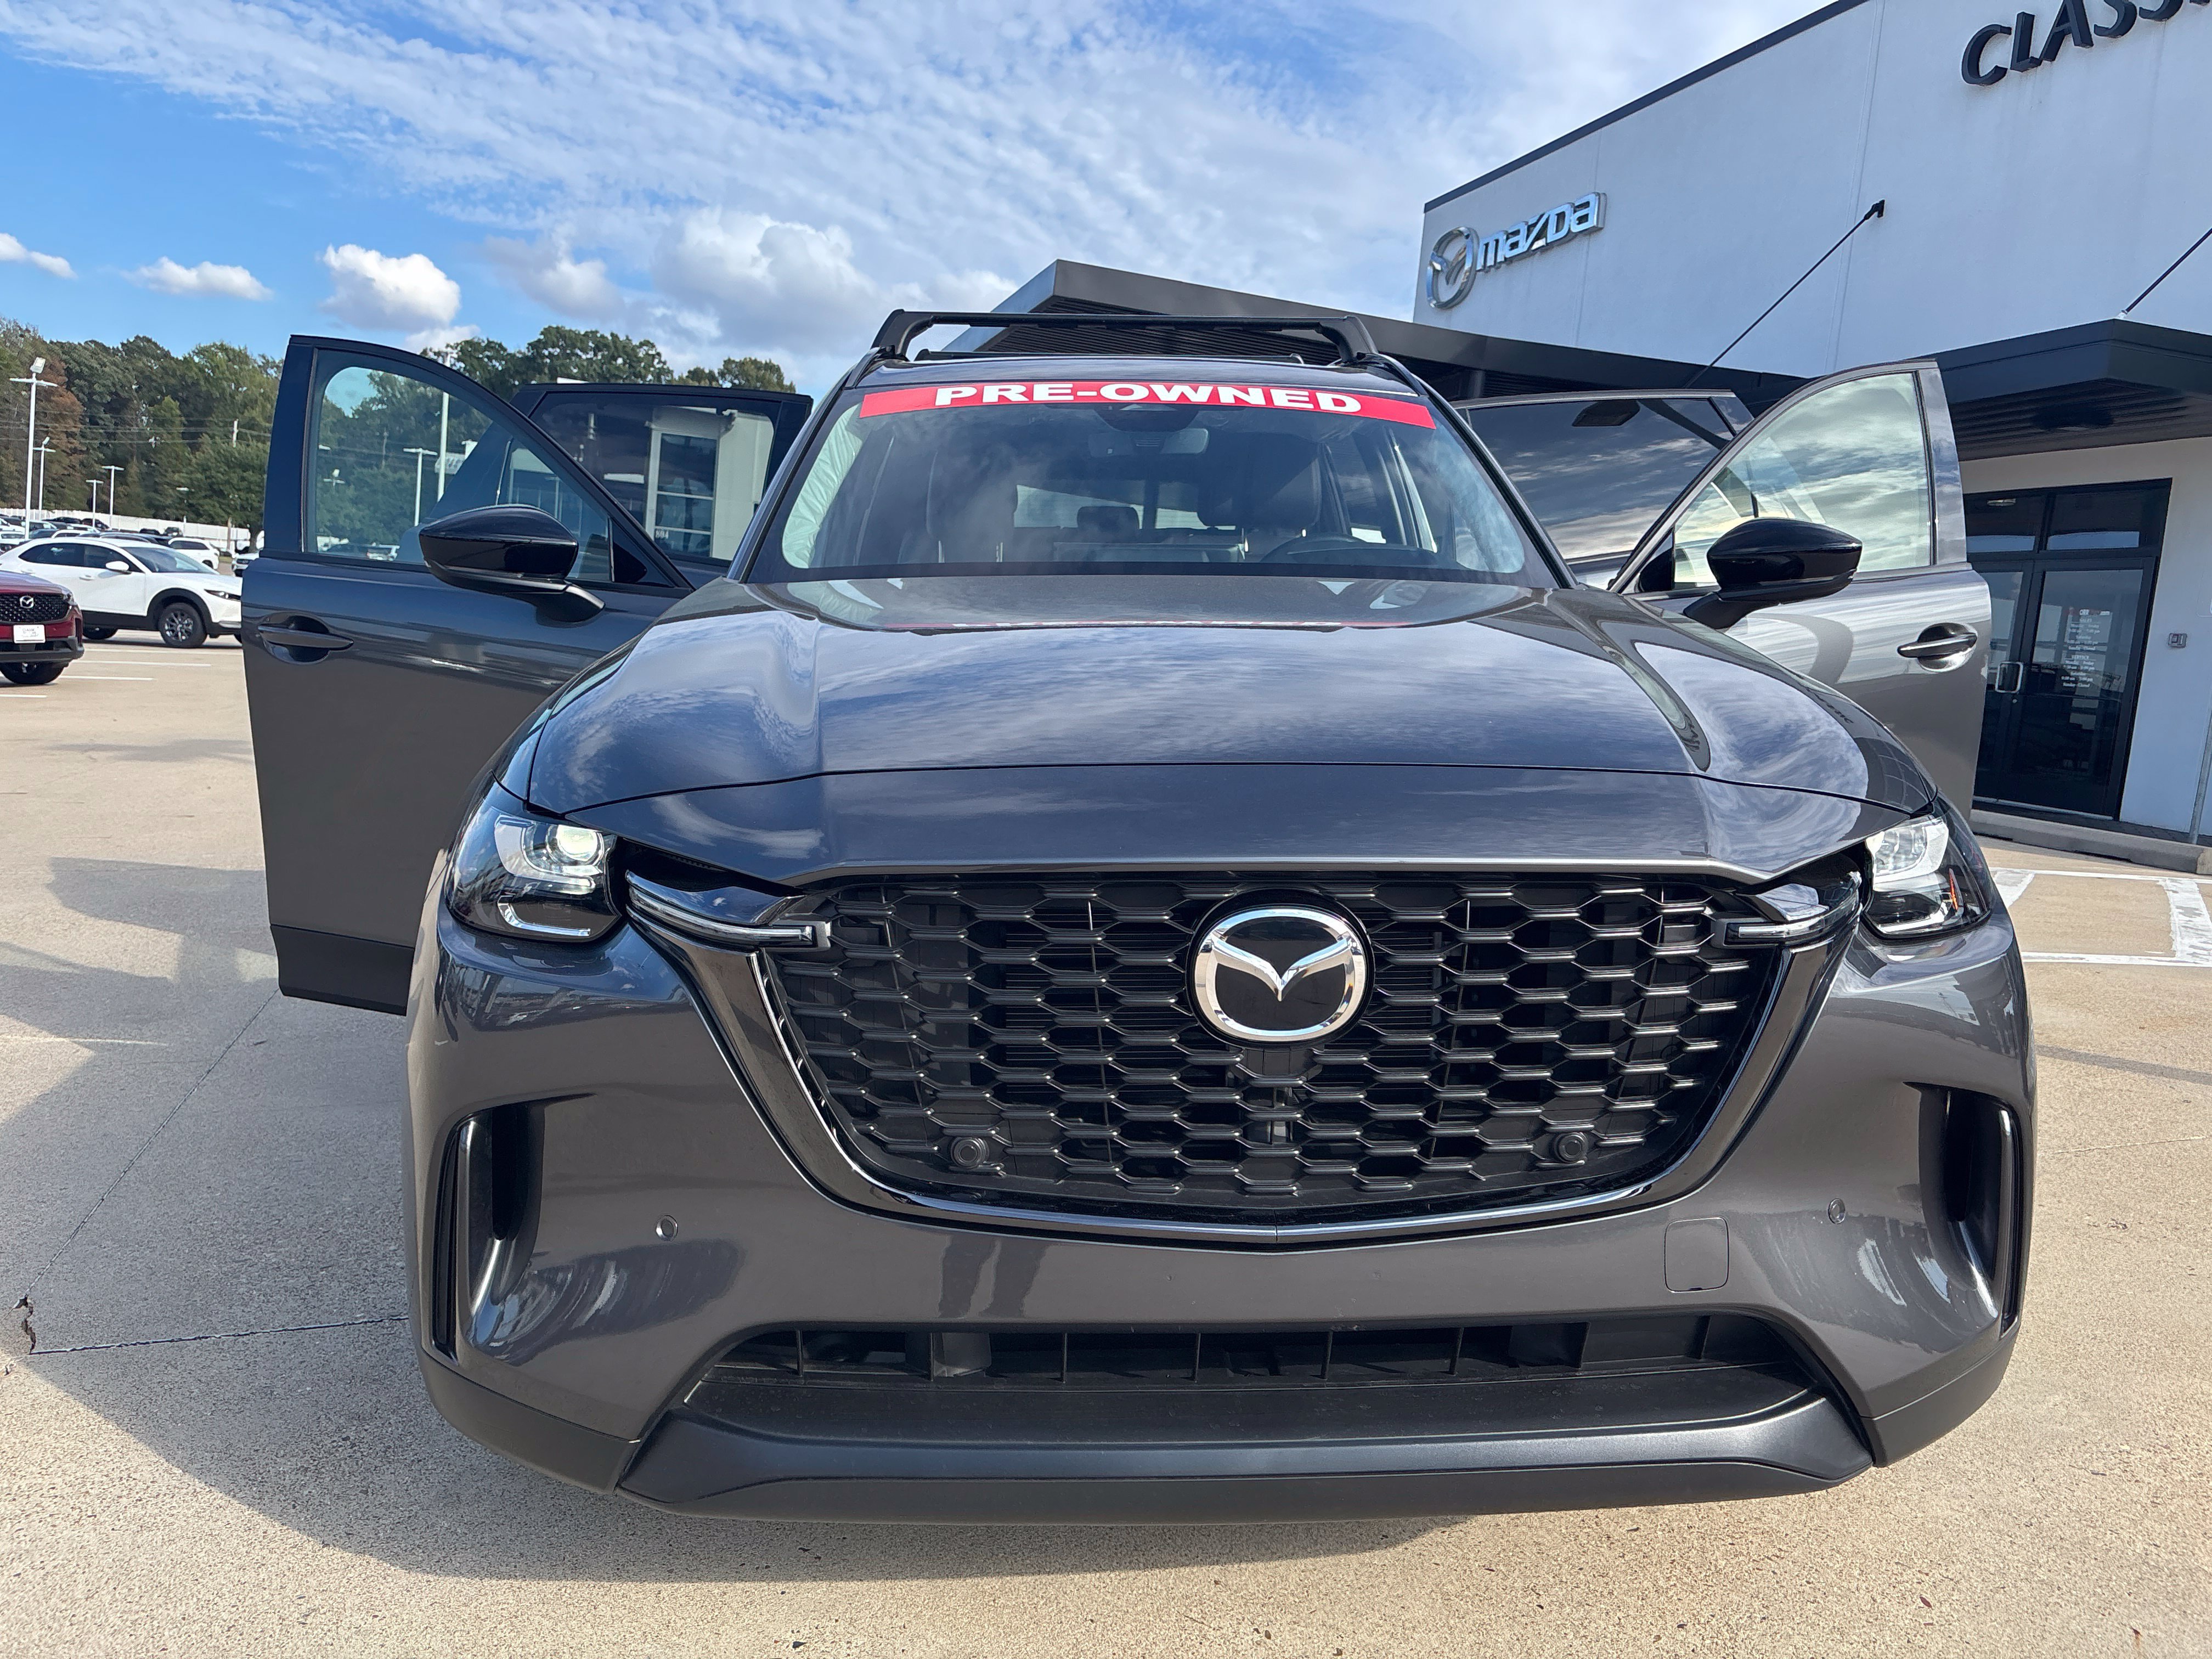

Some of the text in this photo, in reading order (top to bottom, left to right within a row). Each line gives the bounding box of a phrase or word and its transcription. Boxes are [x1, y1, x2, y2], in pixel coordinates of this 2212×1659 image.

[1961, 0, 2210, 86] CLAS
[1476, 192, 1607, 274] mazda
[934, 383, 1362, 414] PRE-OWNED
